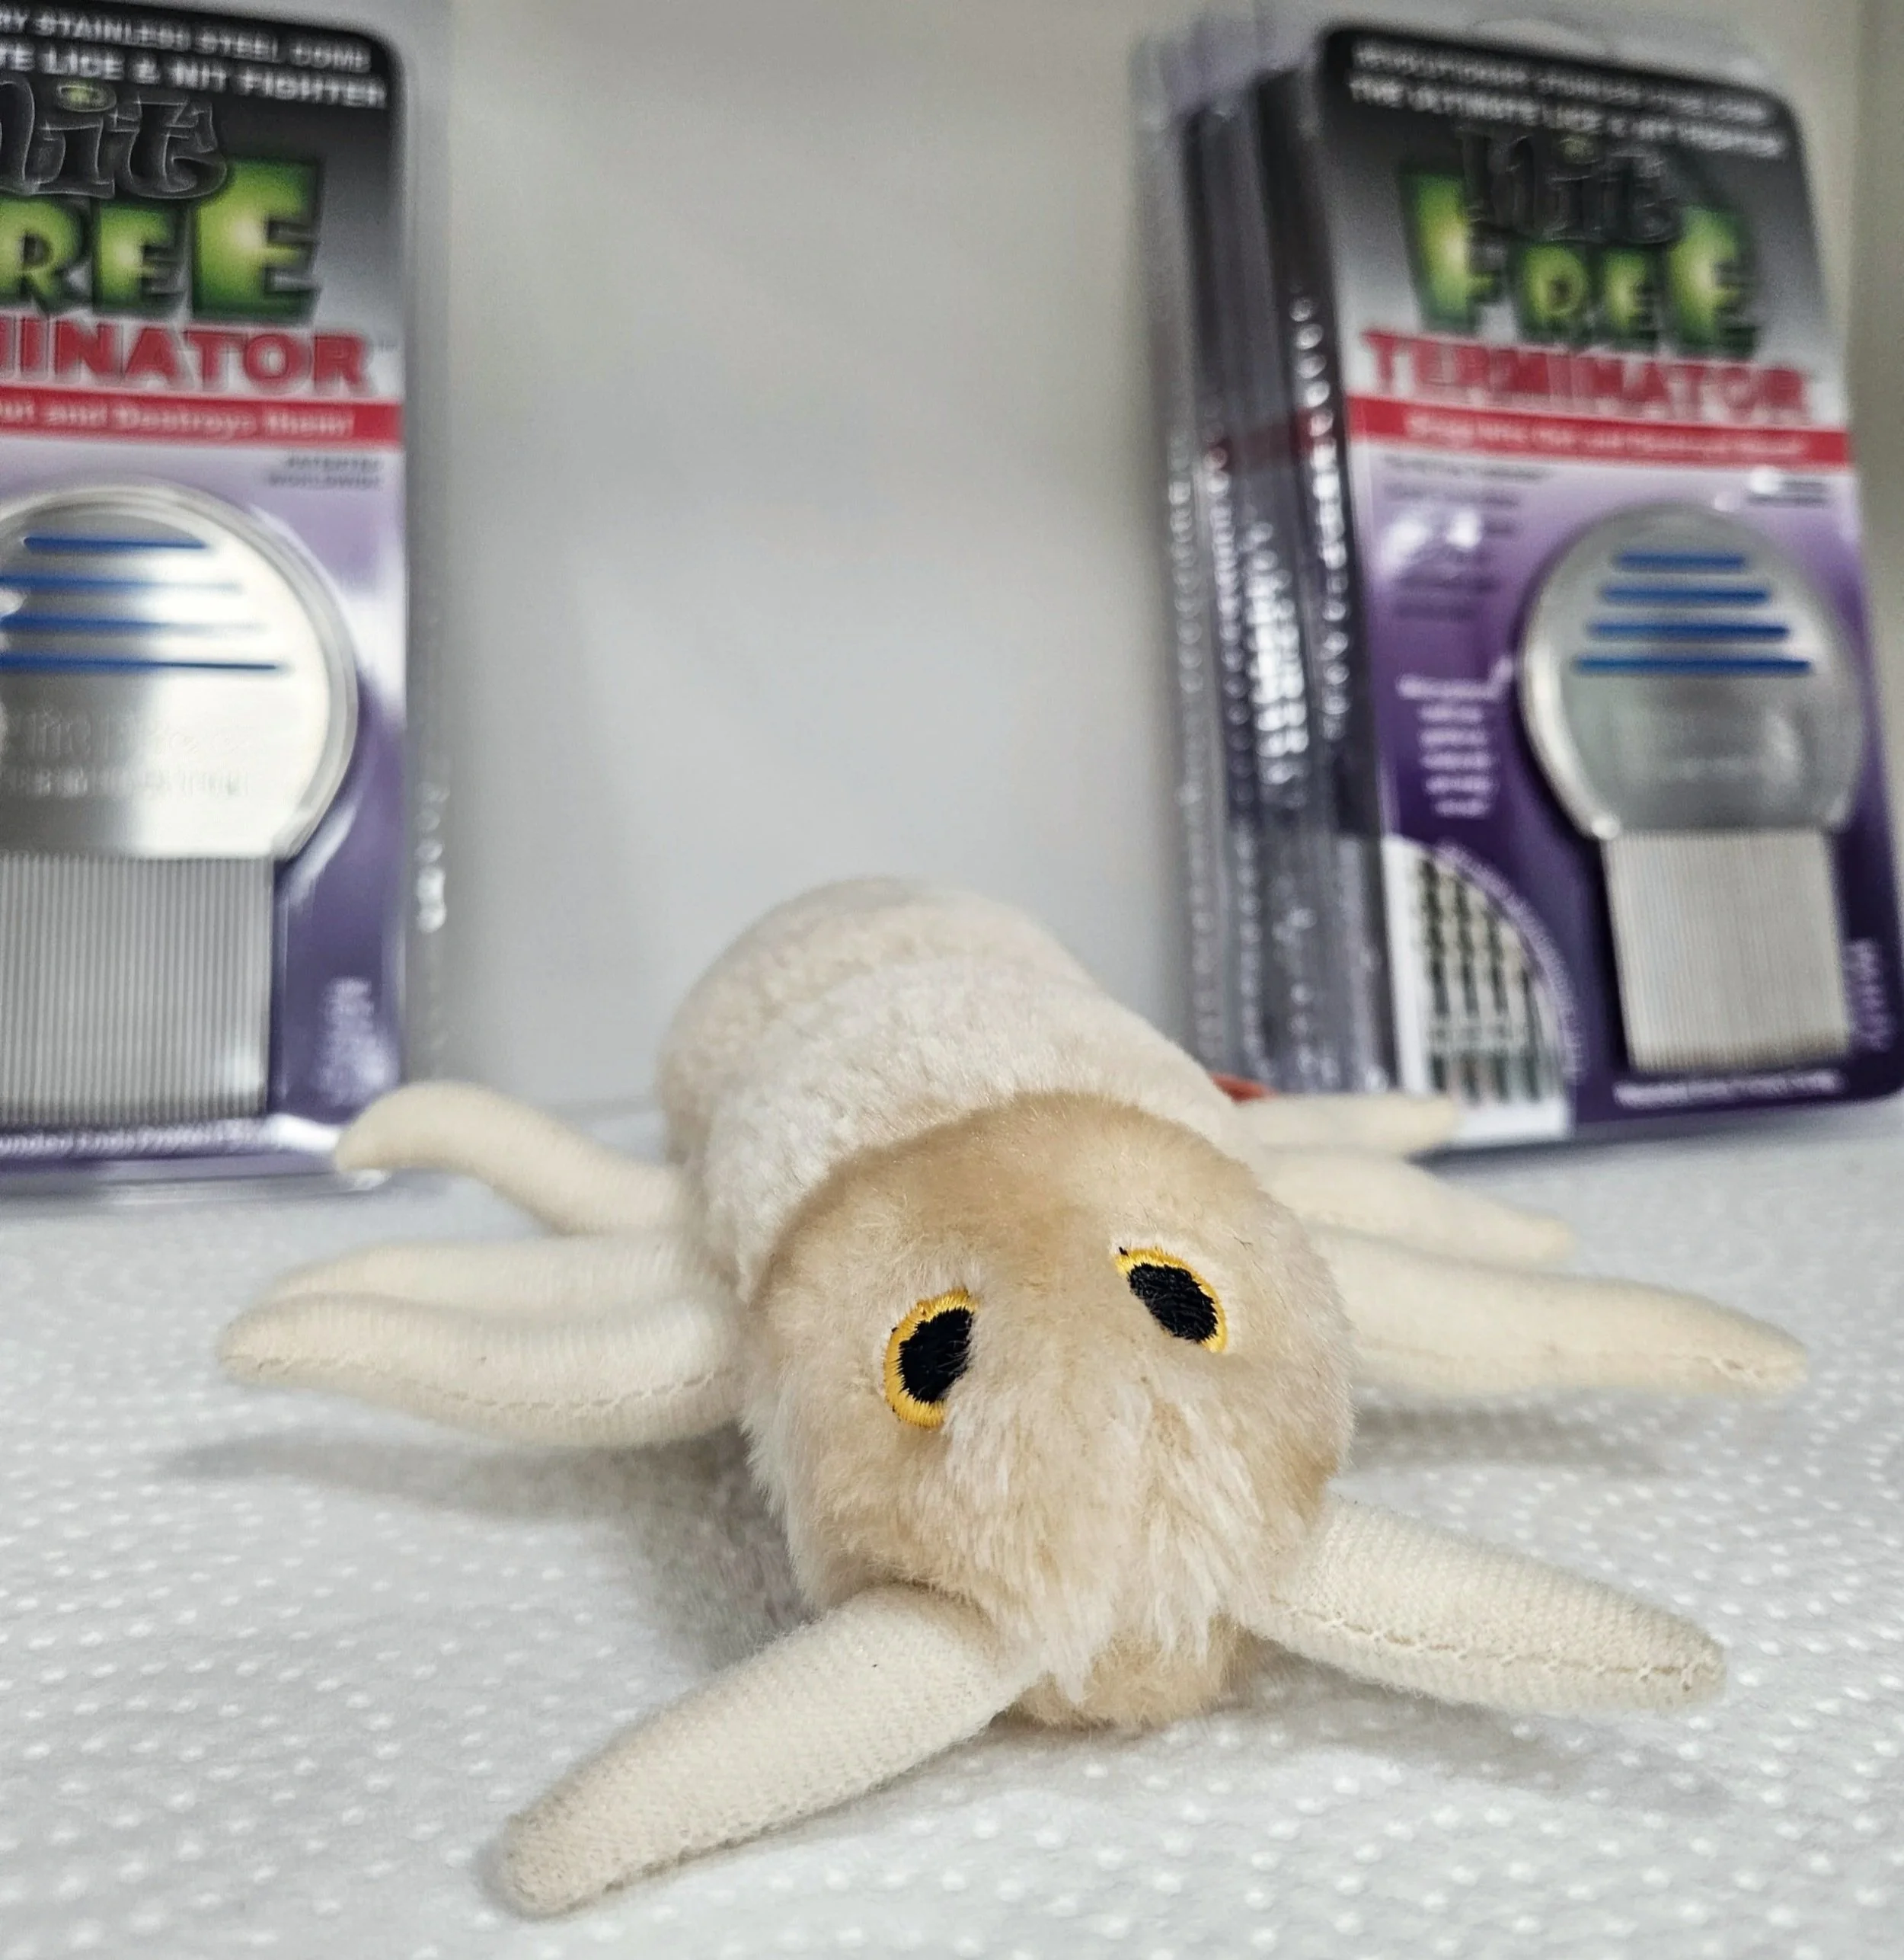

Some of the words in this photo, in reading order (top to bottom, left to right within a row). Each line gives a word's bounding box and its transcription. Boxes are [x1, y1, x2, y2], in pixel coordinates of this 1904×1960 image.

[32, 11, 190, 52] STAINLESS
[194, 26, 279, 62] STEEL
[288, 38, 371, 73] COMB
[39, 46, 125, 81] LICE
[131, 55, 160, 85] &
[166, 61, 228, 93] NIT
[233, 66, 388, 108] FIGHTER
[1400, 163, 1759, 360] FREE
[0, 314, 376, 394] INATOR
[1361, 332, 1810, 425] TERMINATOR
[44, 404, 108, 427] and
[112, 405, 259, 440] Destroys
